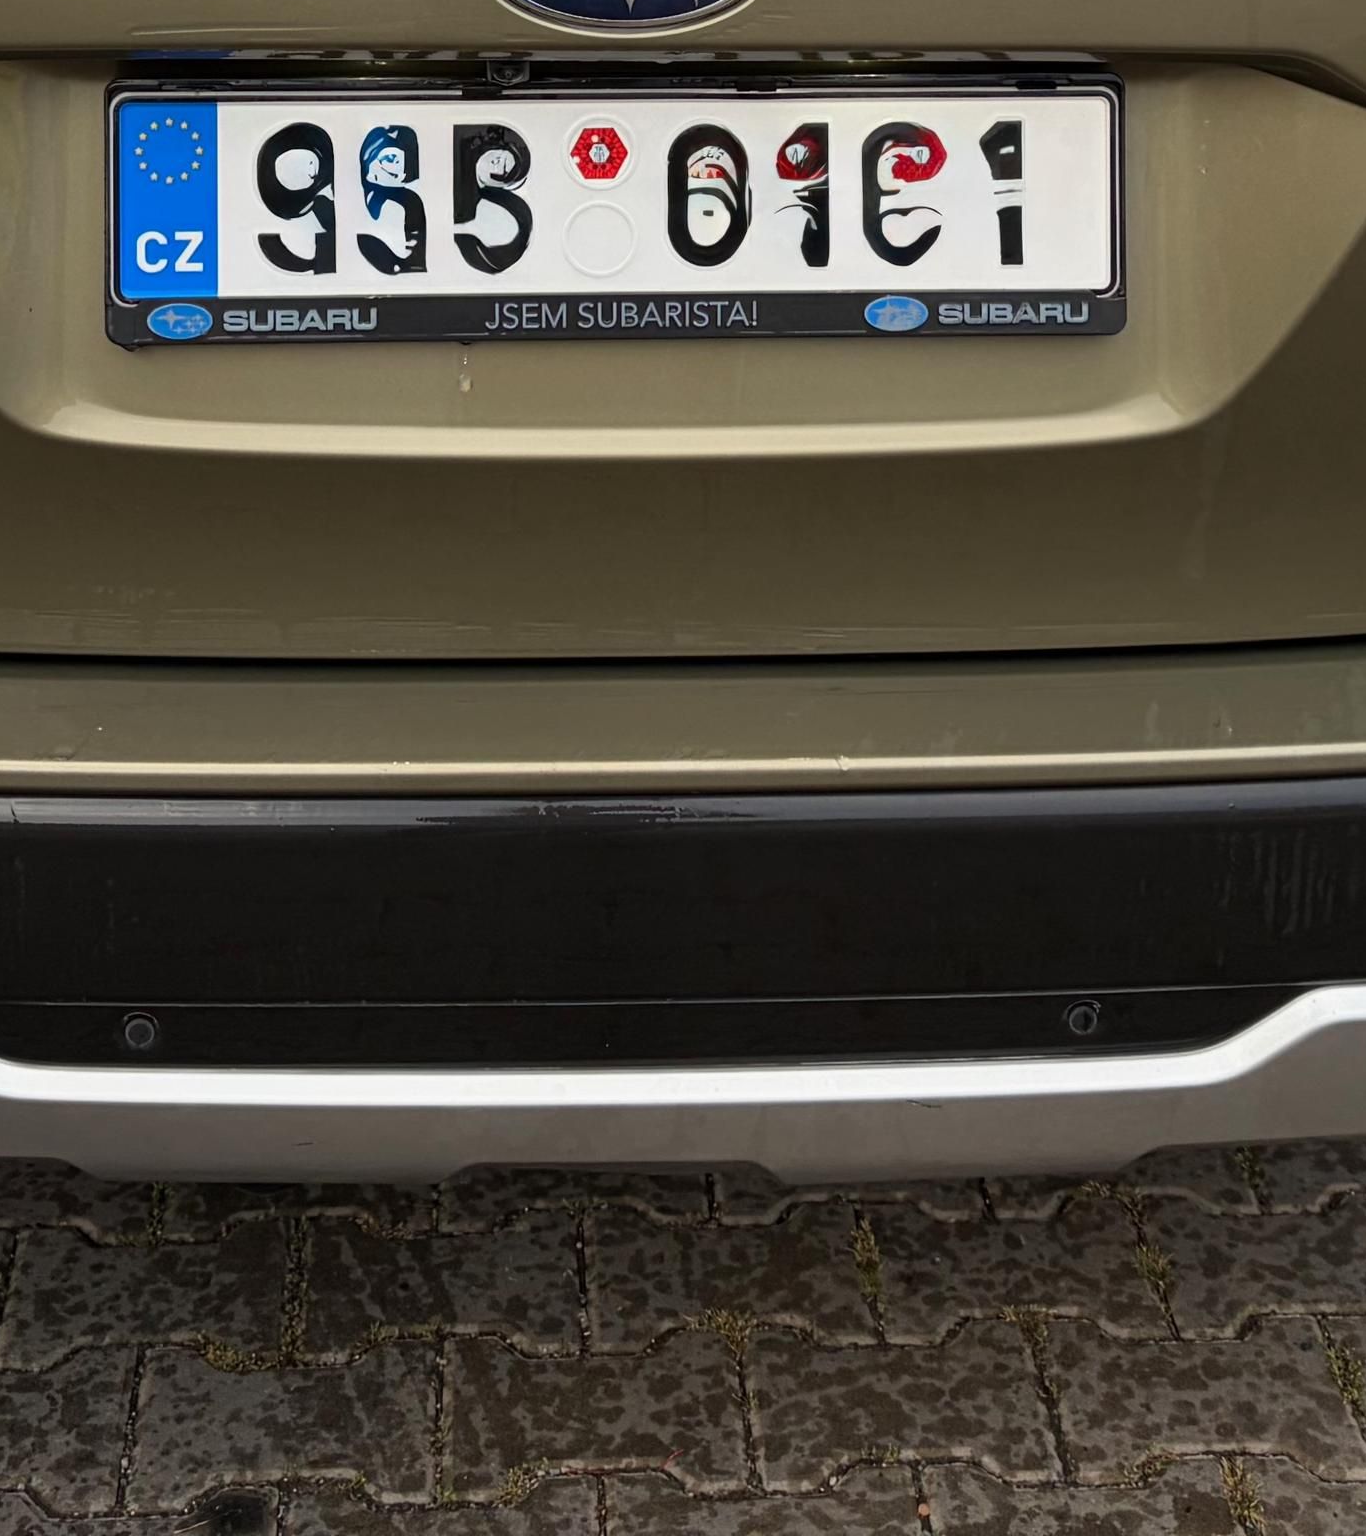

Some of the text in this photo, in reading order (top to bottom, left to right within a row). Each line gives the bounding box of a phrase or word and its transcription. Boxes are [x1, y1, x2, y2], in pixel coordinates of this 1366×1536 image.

[135, 230, 205, 273] CZ
[222, 300, 1090, 333] SUBARU JSEM SUBARISTA! SUBARU
